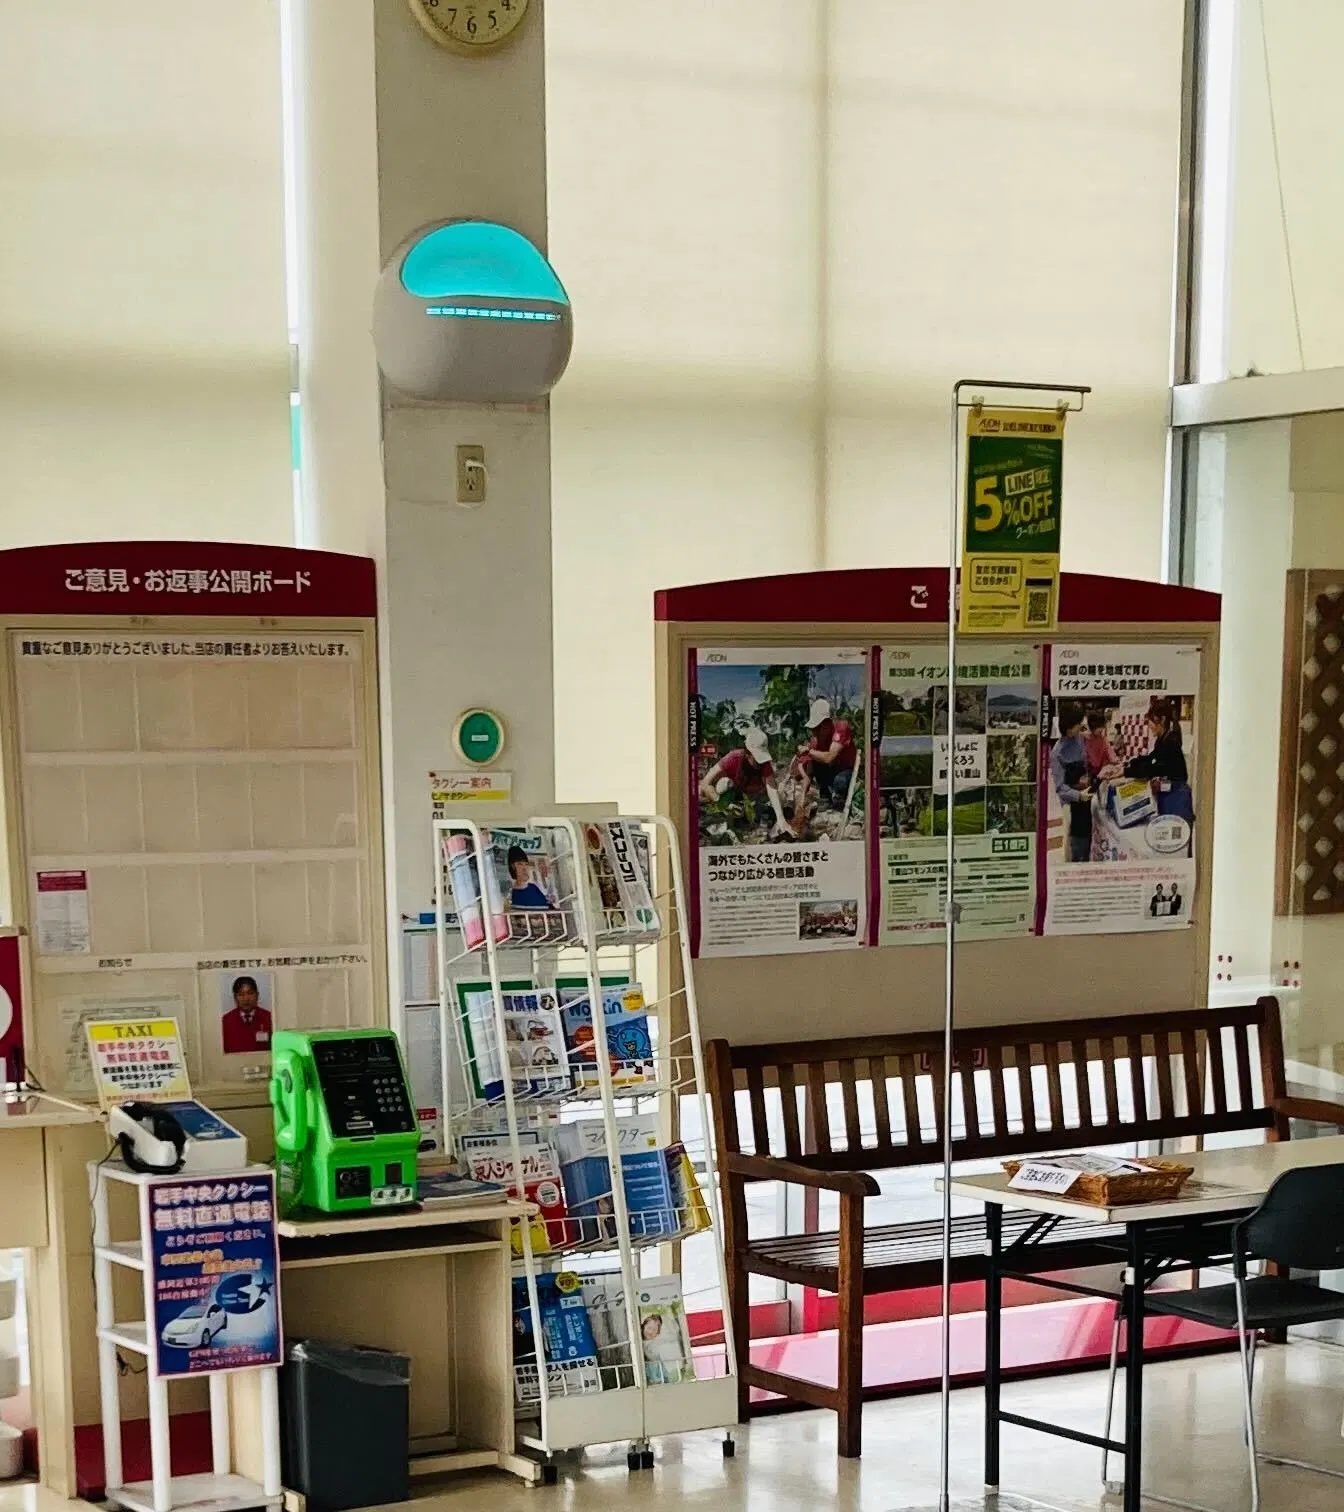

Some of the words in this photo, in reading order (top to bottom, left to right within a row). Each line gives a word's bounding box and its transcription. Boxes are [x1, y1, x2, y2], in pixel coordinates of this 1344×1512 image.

[447, 8, 458, 26] 7
[466, 16, 477, 34] 6
[487, 10, 497, 29] 5
[64, 568, 312, 595] ご意見・お返事公開ボード
[916, 664, 1031, 679] イオン境活動助成公募
[708, 852, 829, 867] 海外でもたくさんの皆さまと
[113, 1025, 153, 1038] TAXI
